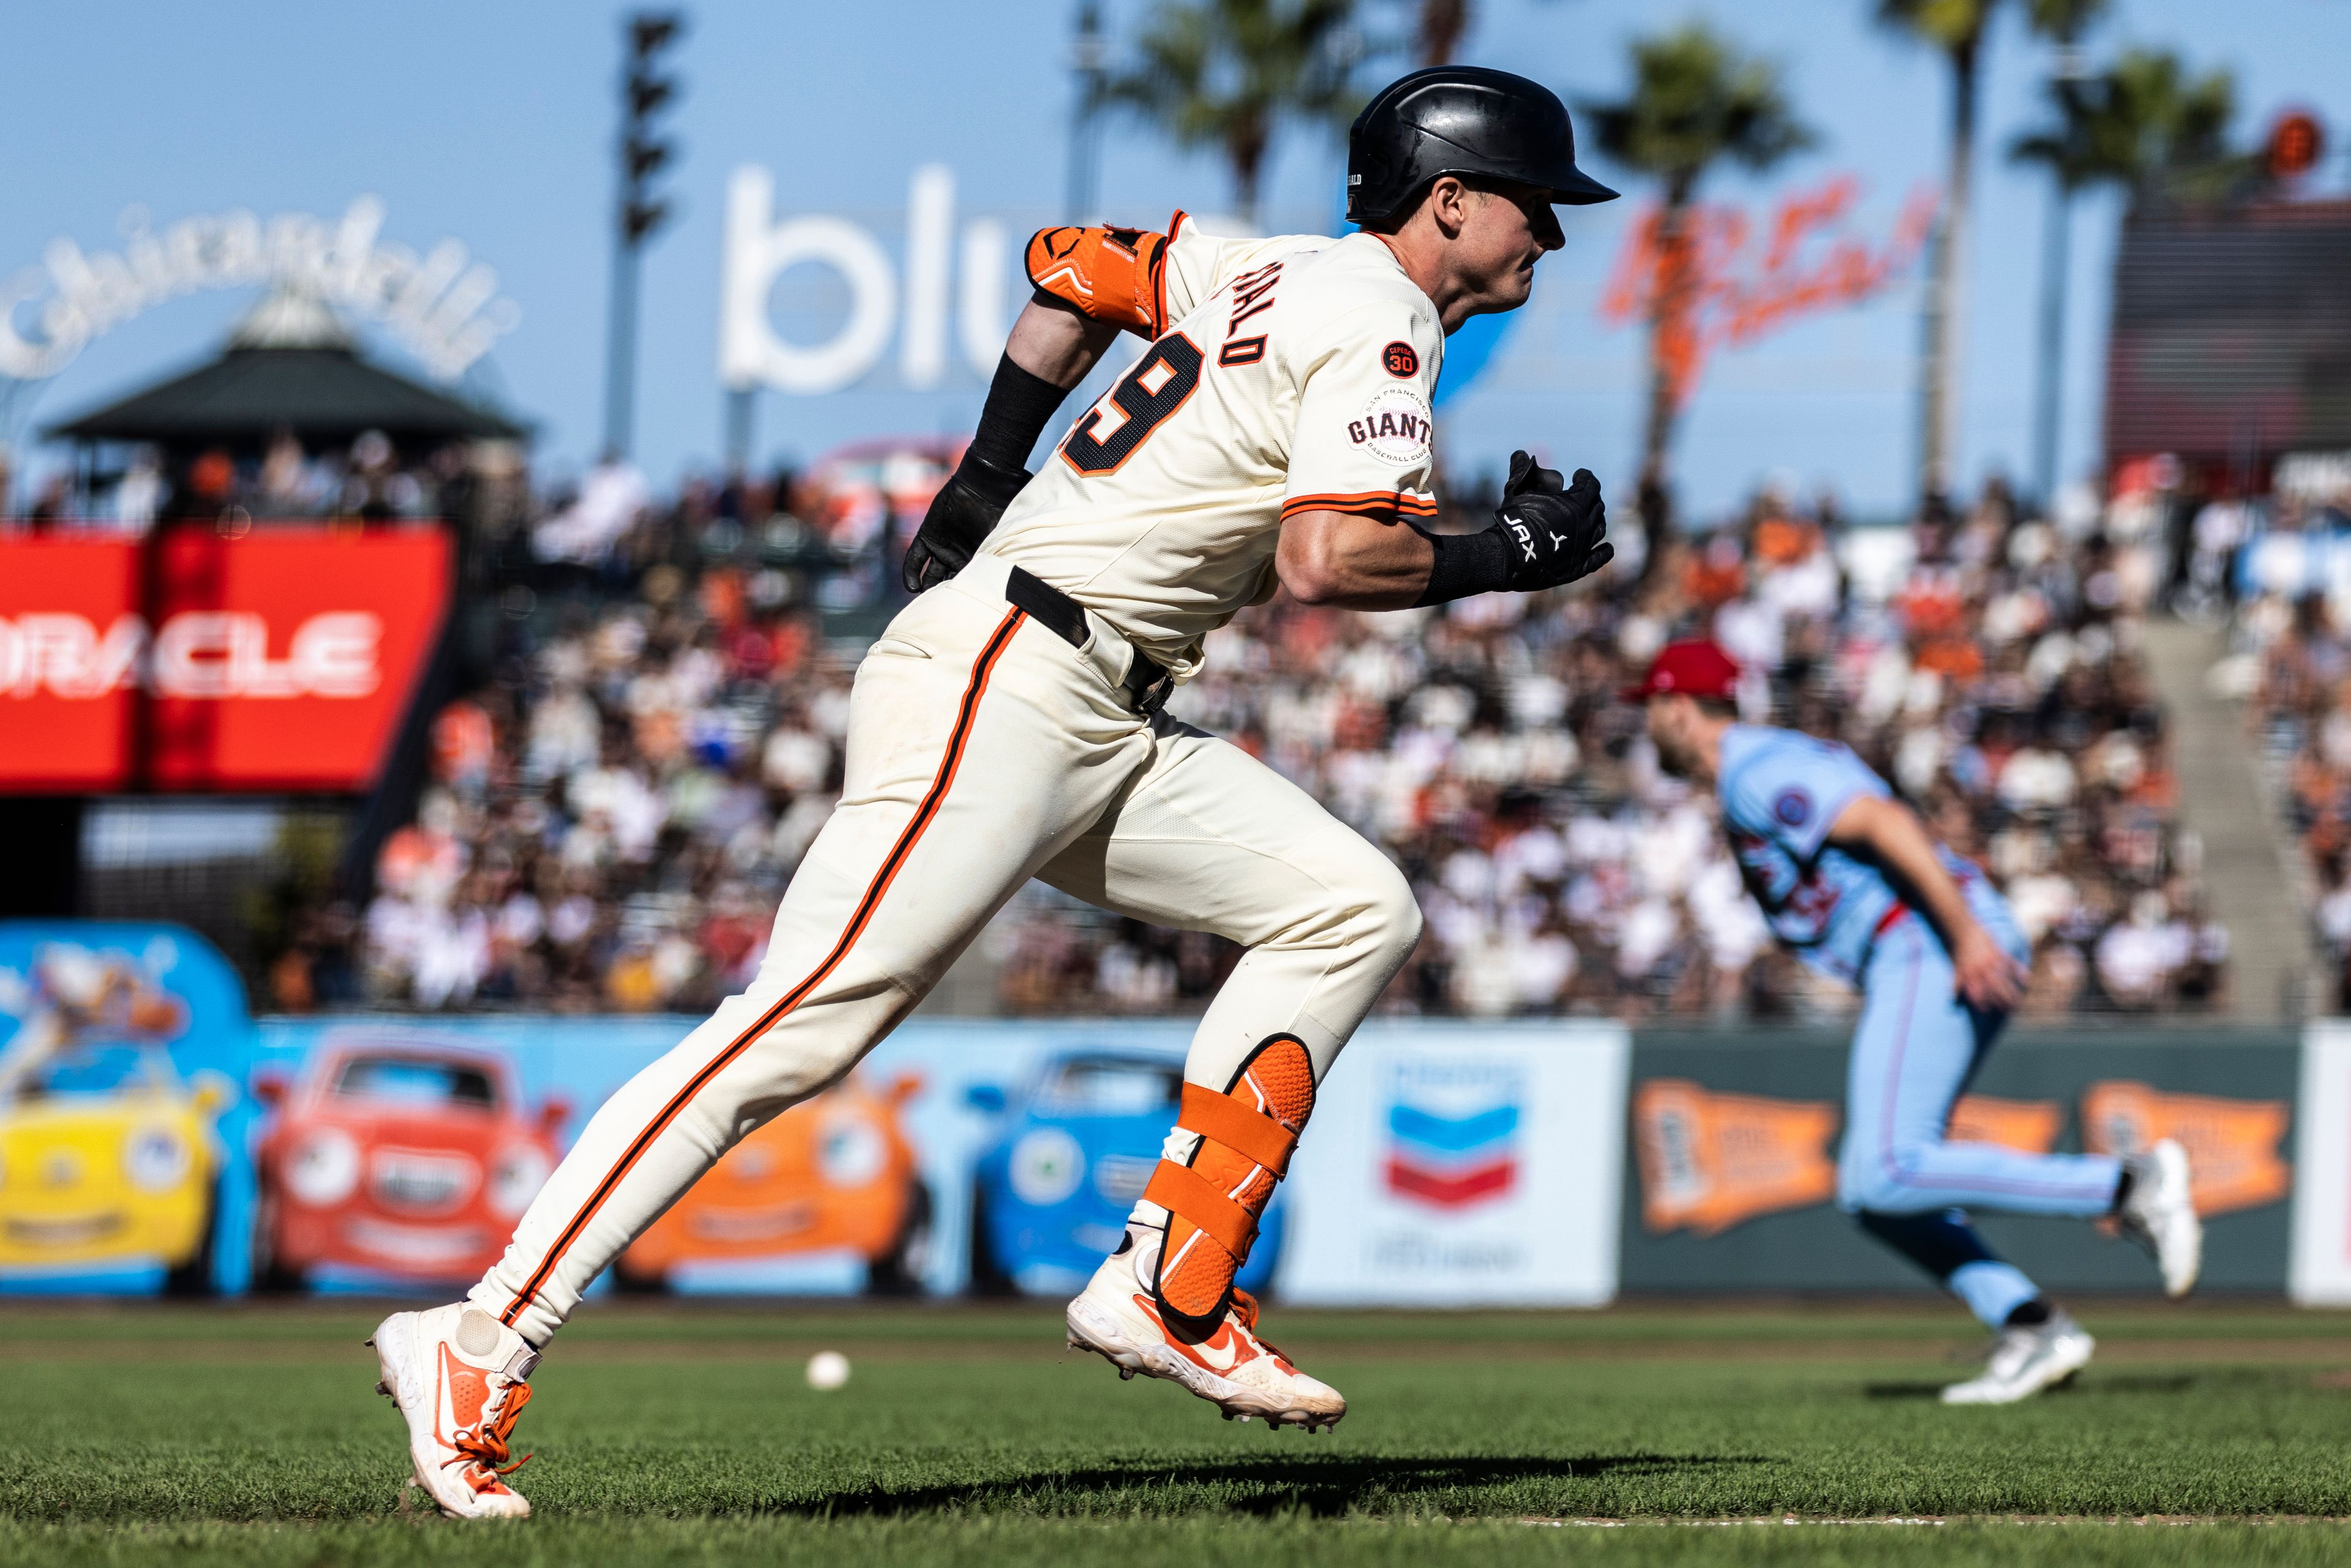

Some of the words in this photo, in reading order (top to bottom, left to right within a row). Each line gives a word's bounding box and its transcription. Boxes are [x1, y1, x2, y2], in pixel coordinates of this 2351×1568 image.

[1389, 347, 1412, 356] CEPEDA
[1389, 354, 1413, 372] 30
[1057, 331, 1205, 478] 9
[1366, 395, 1381, 412] SAN
[1383, 388, 1429, 418] FRANCISCO
[1347, 413, 1433, 454] GIANT
[1367, 441, 1409, 462] BASEBALL
[1411, 448, 1427, 460] CLUB
[1504, 514, 1537, 562] JAX
